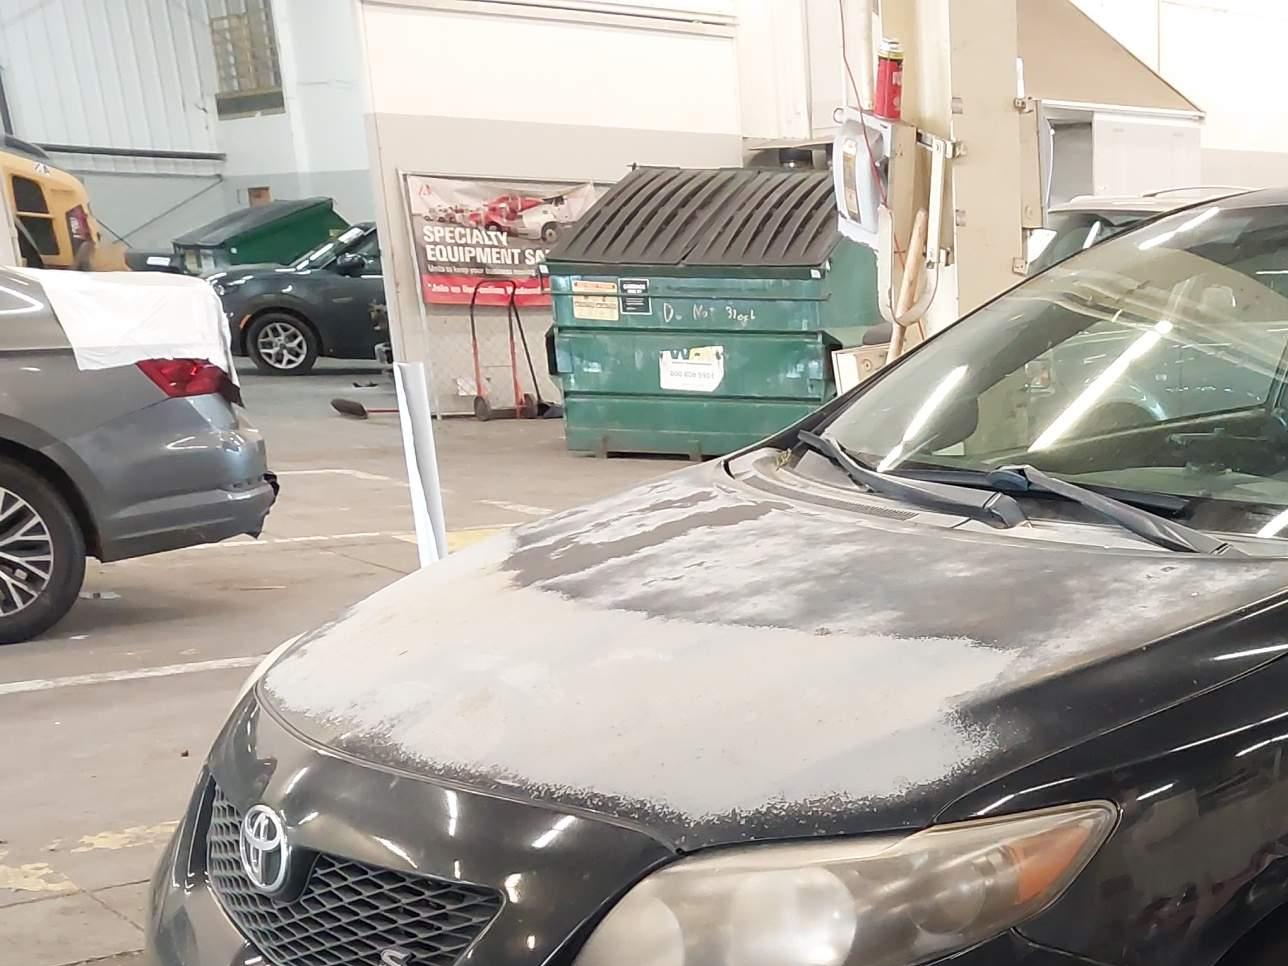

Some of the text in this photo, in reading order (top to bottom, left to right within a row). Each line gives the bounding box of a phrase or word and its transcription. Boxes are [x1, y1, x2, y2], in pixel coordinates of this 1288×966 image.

[422, 225, 509, 246] SPECIALTY
[425, 244, 551, 266] EQUIPMENT SA
